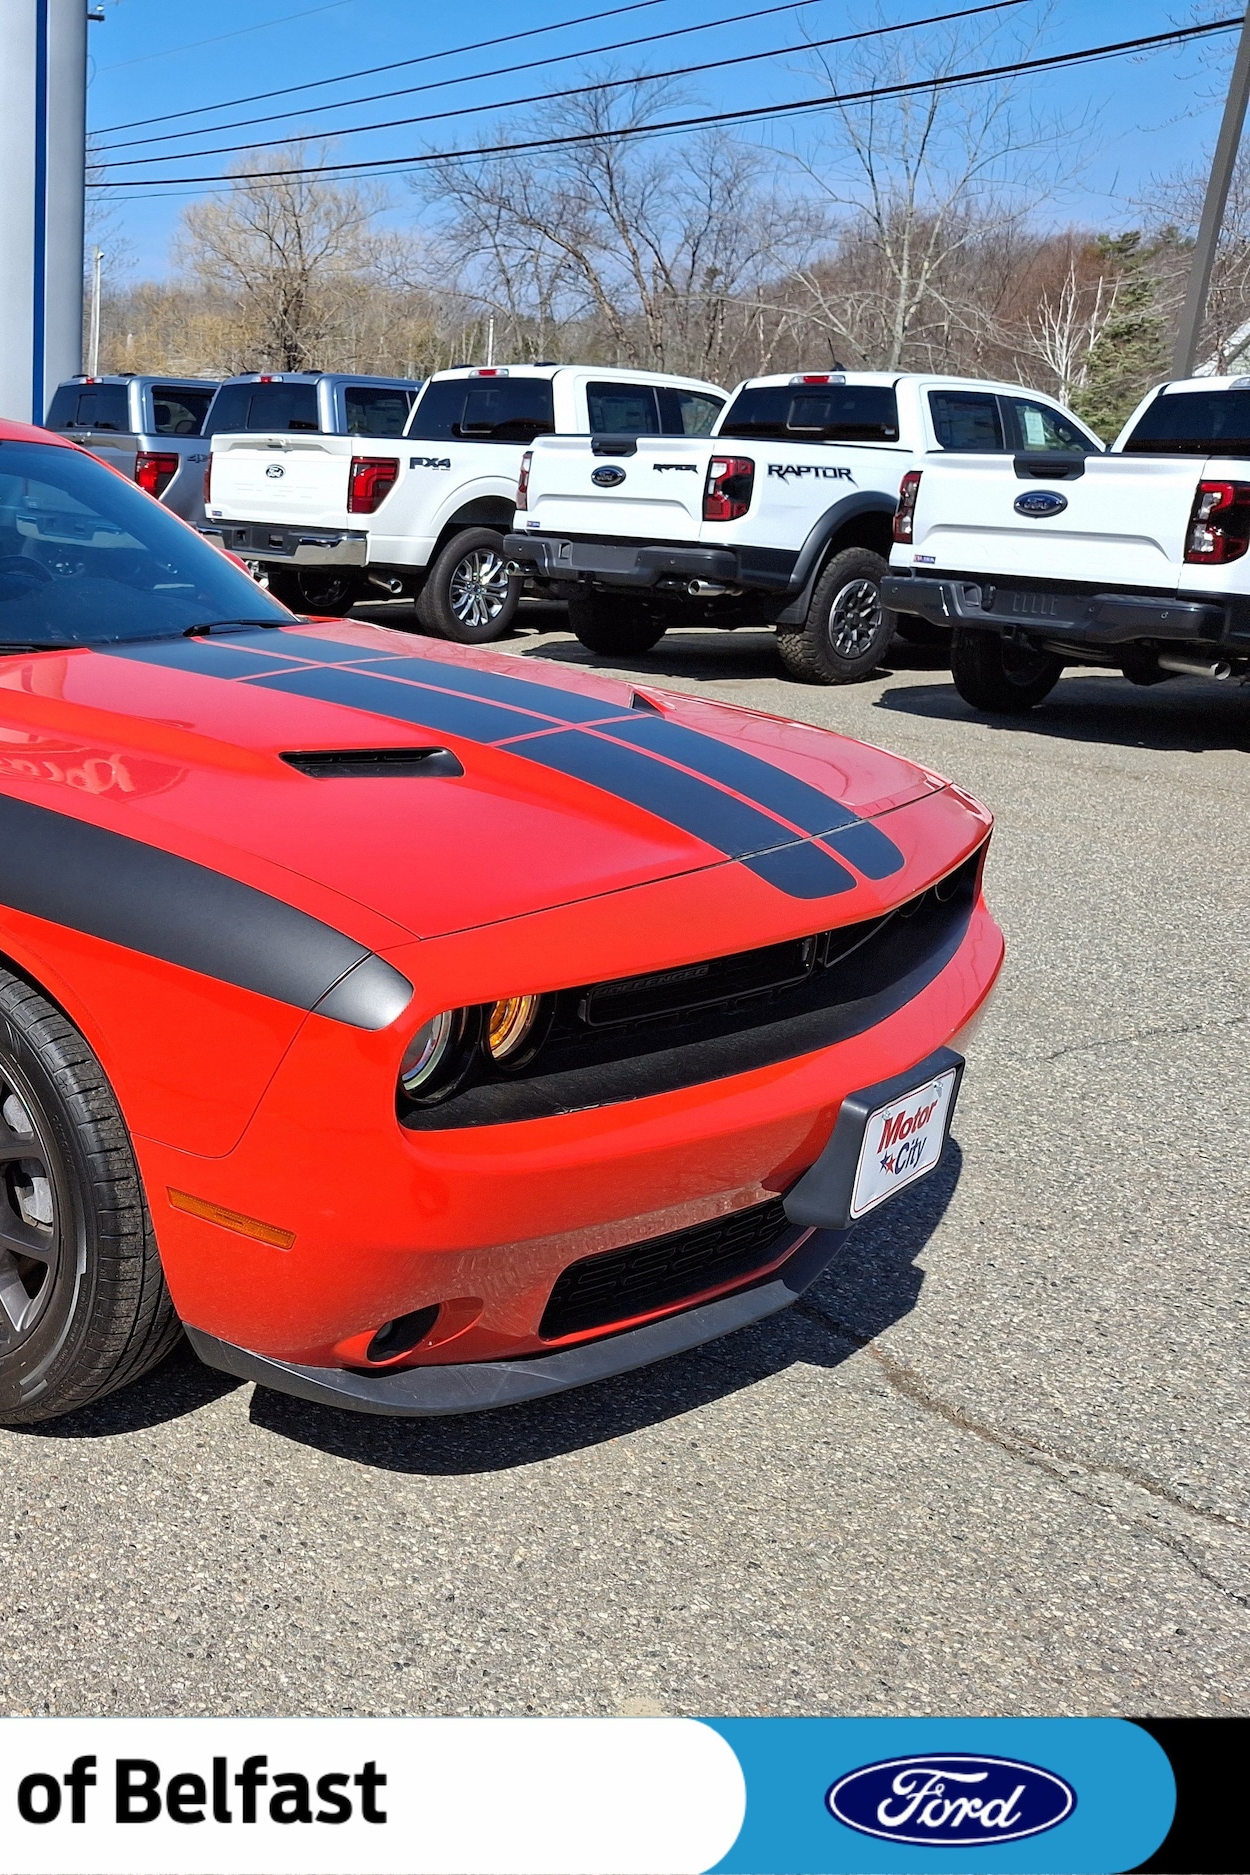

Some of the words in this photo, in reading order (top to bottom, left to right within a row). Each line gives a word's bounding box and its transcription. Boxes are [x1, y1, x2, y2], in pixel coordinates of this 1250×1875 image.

[409, 457, 451, 470] FX4
[767, 464, 860, 488] RAPTOR
[877, 1099, 938, 1154] Motor
[894, 1136, 928, 1175] City
